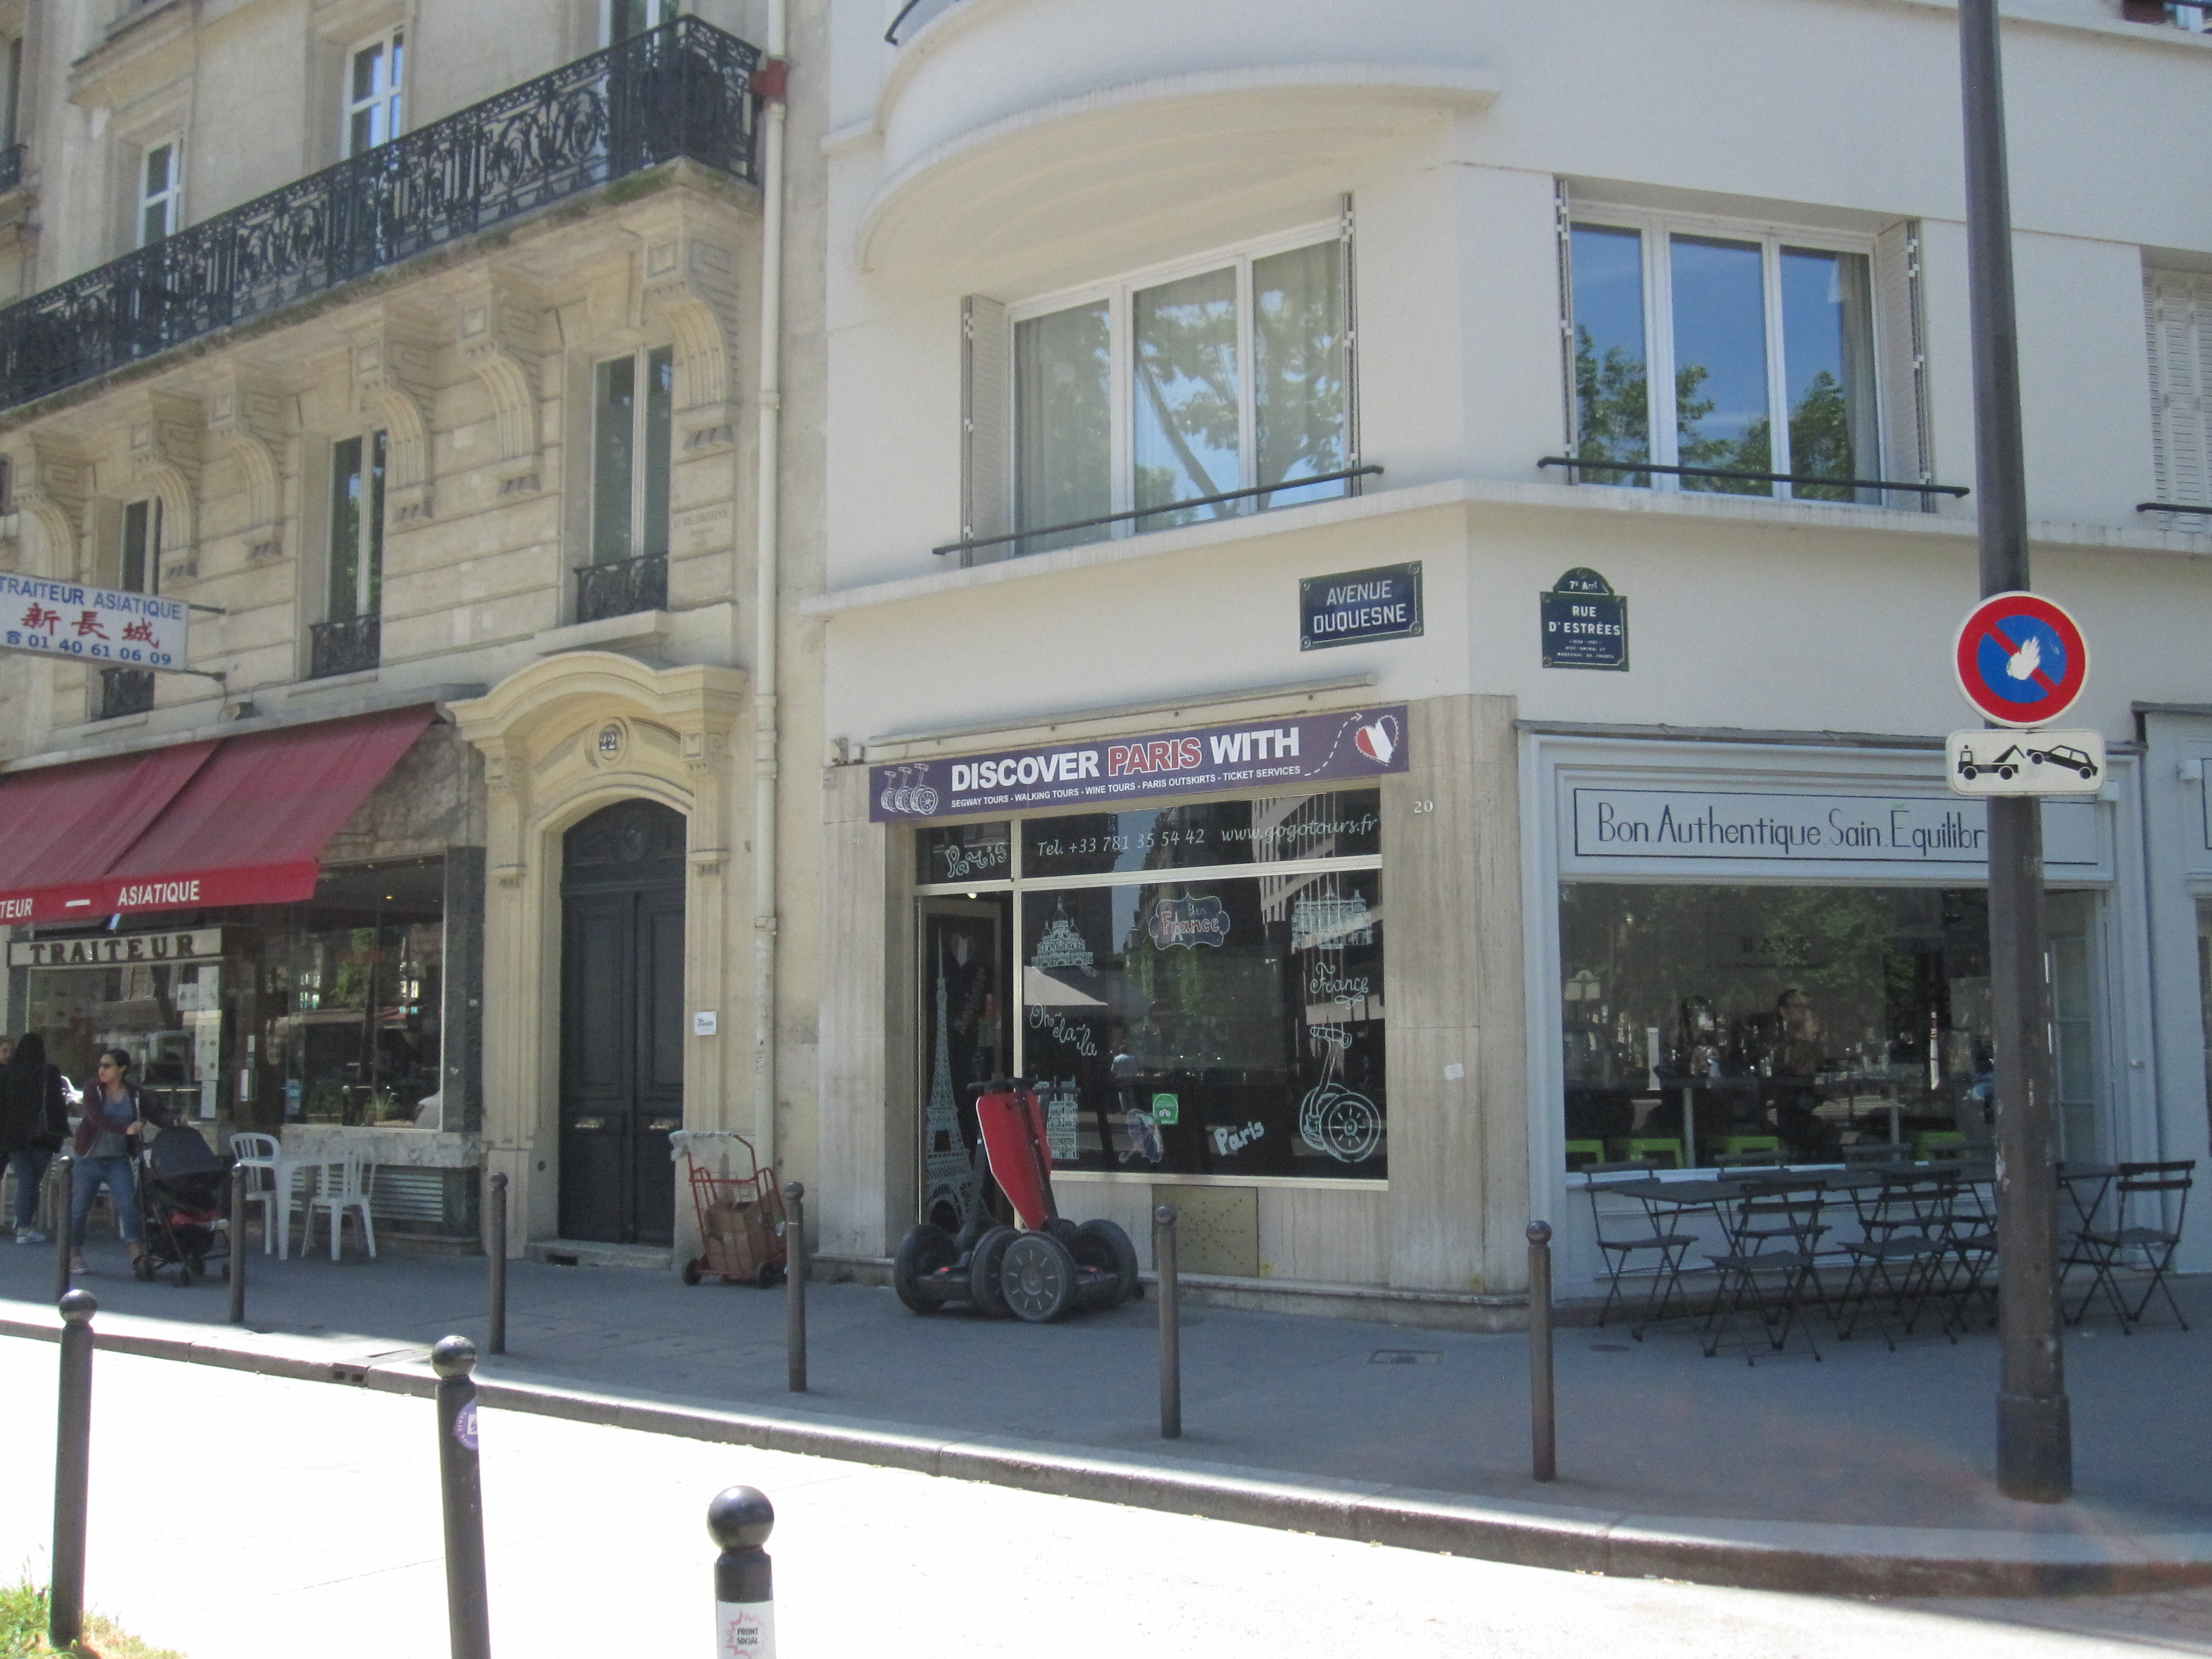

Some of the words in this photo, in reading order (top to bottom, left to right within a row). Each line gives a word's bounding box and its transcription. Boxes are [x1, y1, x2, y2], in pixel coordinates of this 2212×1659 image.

[0, 576, 85, 606] TRAITEUR
[93, 592, 181, 620] ASIATIQUE
[1327, 580, 1392, 606] AVENUE
[1314, 603, 1407, 634] DUQUESNE
[1572, 606, 1597, 617] RUE
[28, 634, 49, 649] 01
[59, 639, 83, 654] 40
[91, 644, 109, 658] 61
[119, 647, 142, 662] 06
[150, 651, 172, 666] 09
[951, 750, 1100, 792] DISCOVER
[1108, 737, 1202, 778] PARIS
[1209, 727, 1300, 765] WITH
[951, 798, 982, 808] SEGWAY
[983, 795, 1009, 805] TOURS
[1014, 792, 1051, 802] WALKING
[1053, 789, 1079, 800] TOURS
[1085, 785, 1107, 795] WINE
[1108, 782, 1136, 793] TOURS
[1142, 780, 1167, 790] PARIS
[1168, 774, 1216, 787] OUTSKIRTS
[1223, 770, 1254, 781] TICKET
[1256, 765, 1301, 778] SERVICES
[1414, 801, 1433, 813] 20
[1038, 839, 1064, 857] Tel.
[1069, 837, 1097, 854] +33
[1103, 836, 1129, 852] 781
[1137, 833, 1155, 849] 35
[1161, 831, 1181, 847] 54
[1185, 828, 1205, 845] 42
[1220, 812, 1378, 843] www.gogotours.fr
[946, 842, 1008, 878] Paris
[117, 879, 201, 907] ASIATIQUE
[1161, 911, 1220, 935] France
[30, 935, 196, 964] TRAITEUR
[1310, 962, 1369, 995] France
[1214, 1120, 1265, 1156] Paris
[737, 1627, 759, 1636] FRONT
